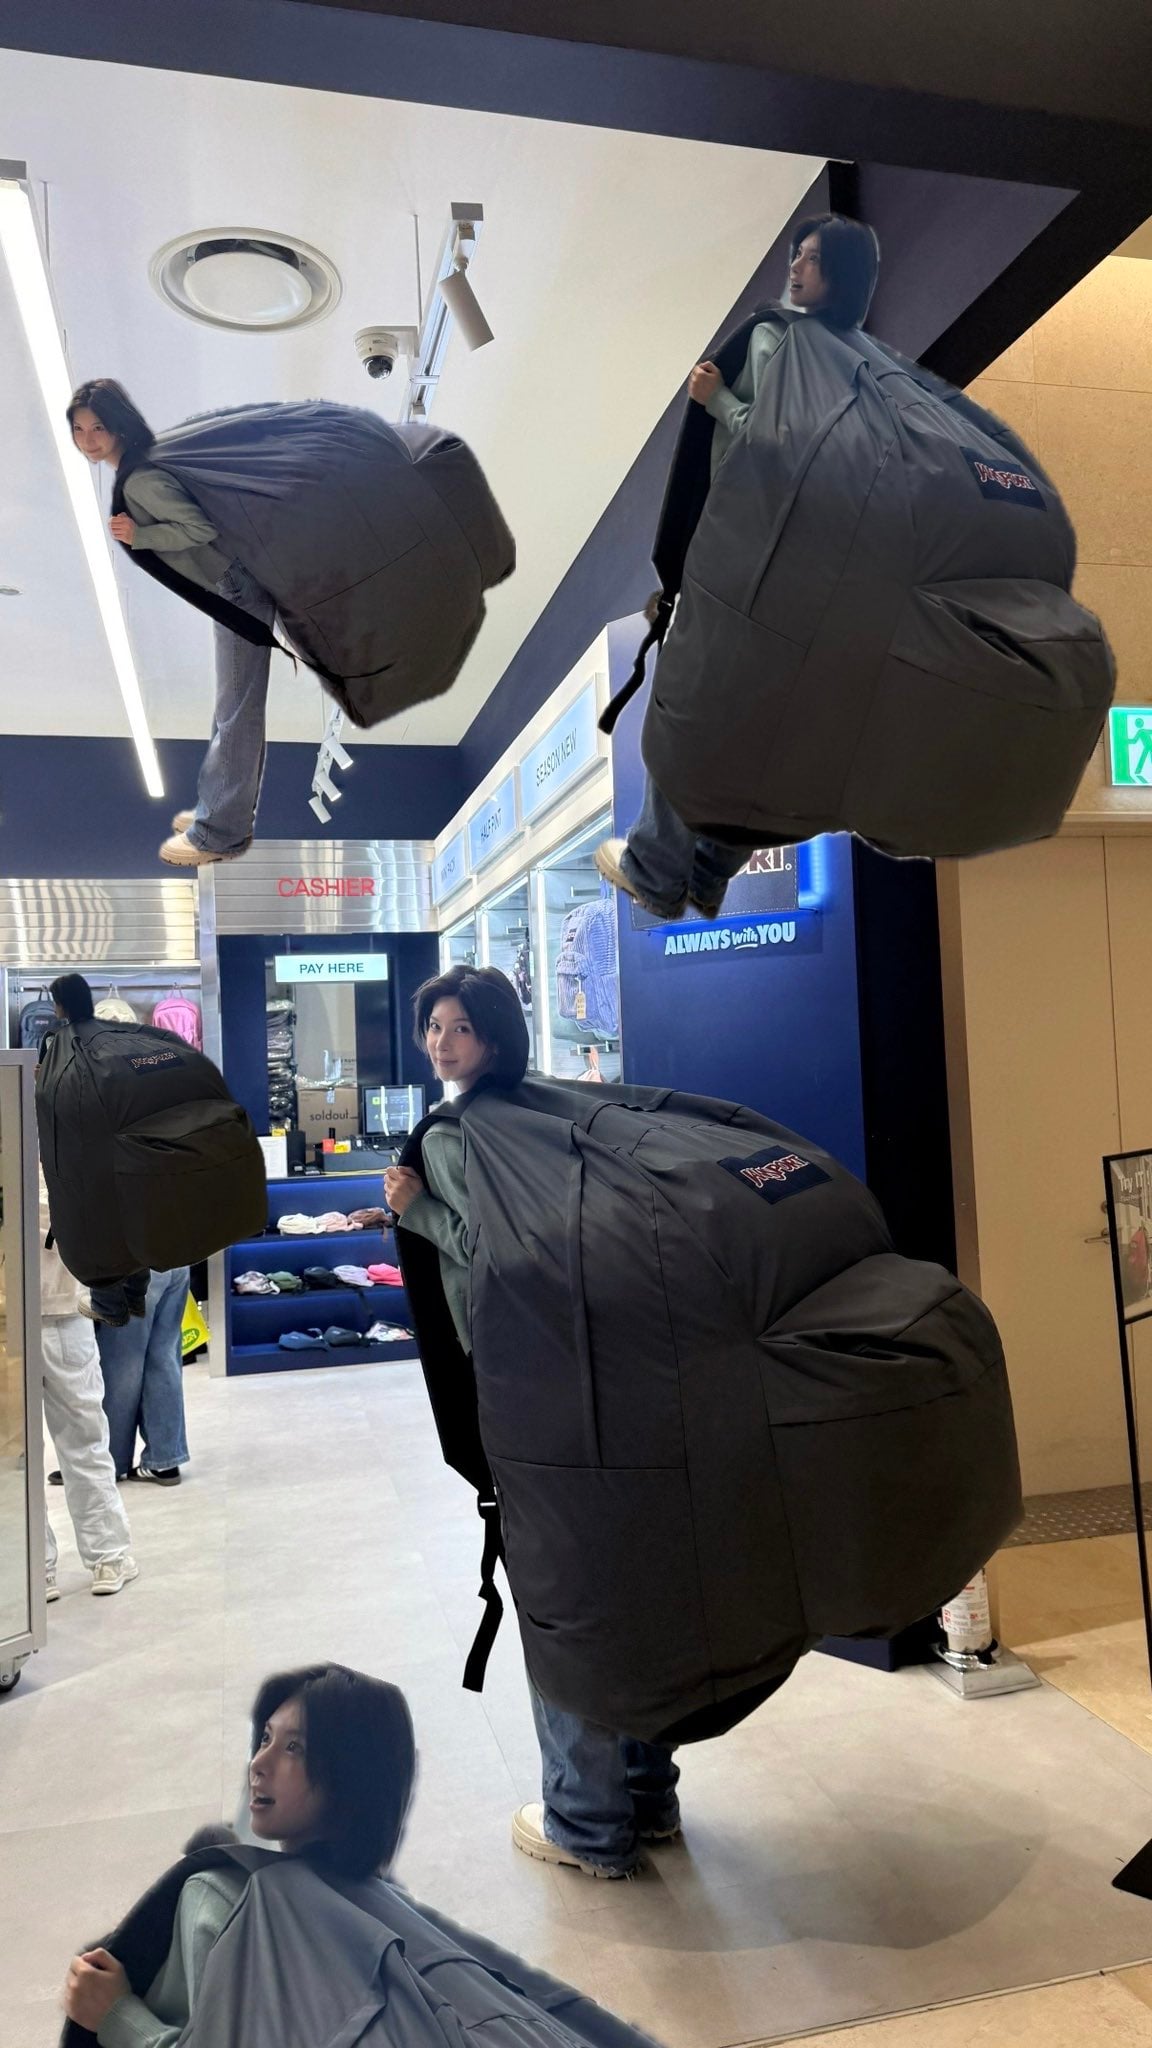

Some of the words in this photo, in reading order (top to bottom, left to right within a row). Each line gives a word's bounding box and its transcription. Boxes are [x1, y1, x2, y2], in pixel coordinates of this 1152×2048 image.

[536, 746, 560, 787] SEASON
[561, 727, 577, 762] NEW
[277, 876, 376, 897] CASHIER
[665, 929, 731, 955] ALWAYS
[732, 926, 758, 946] with
[756, 921, 796, 945] YOU
[299, 963, 324, 974] PAY
[328, 962, 364, 973] HERE
[310, 1109, 349, 1122] soldout
